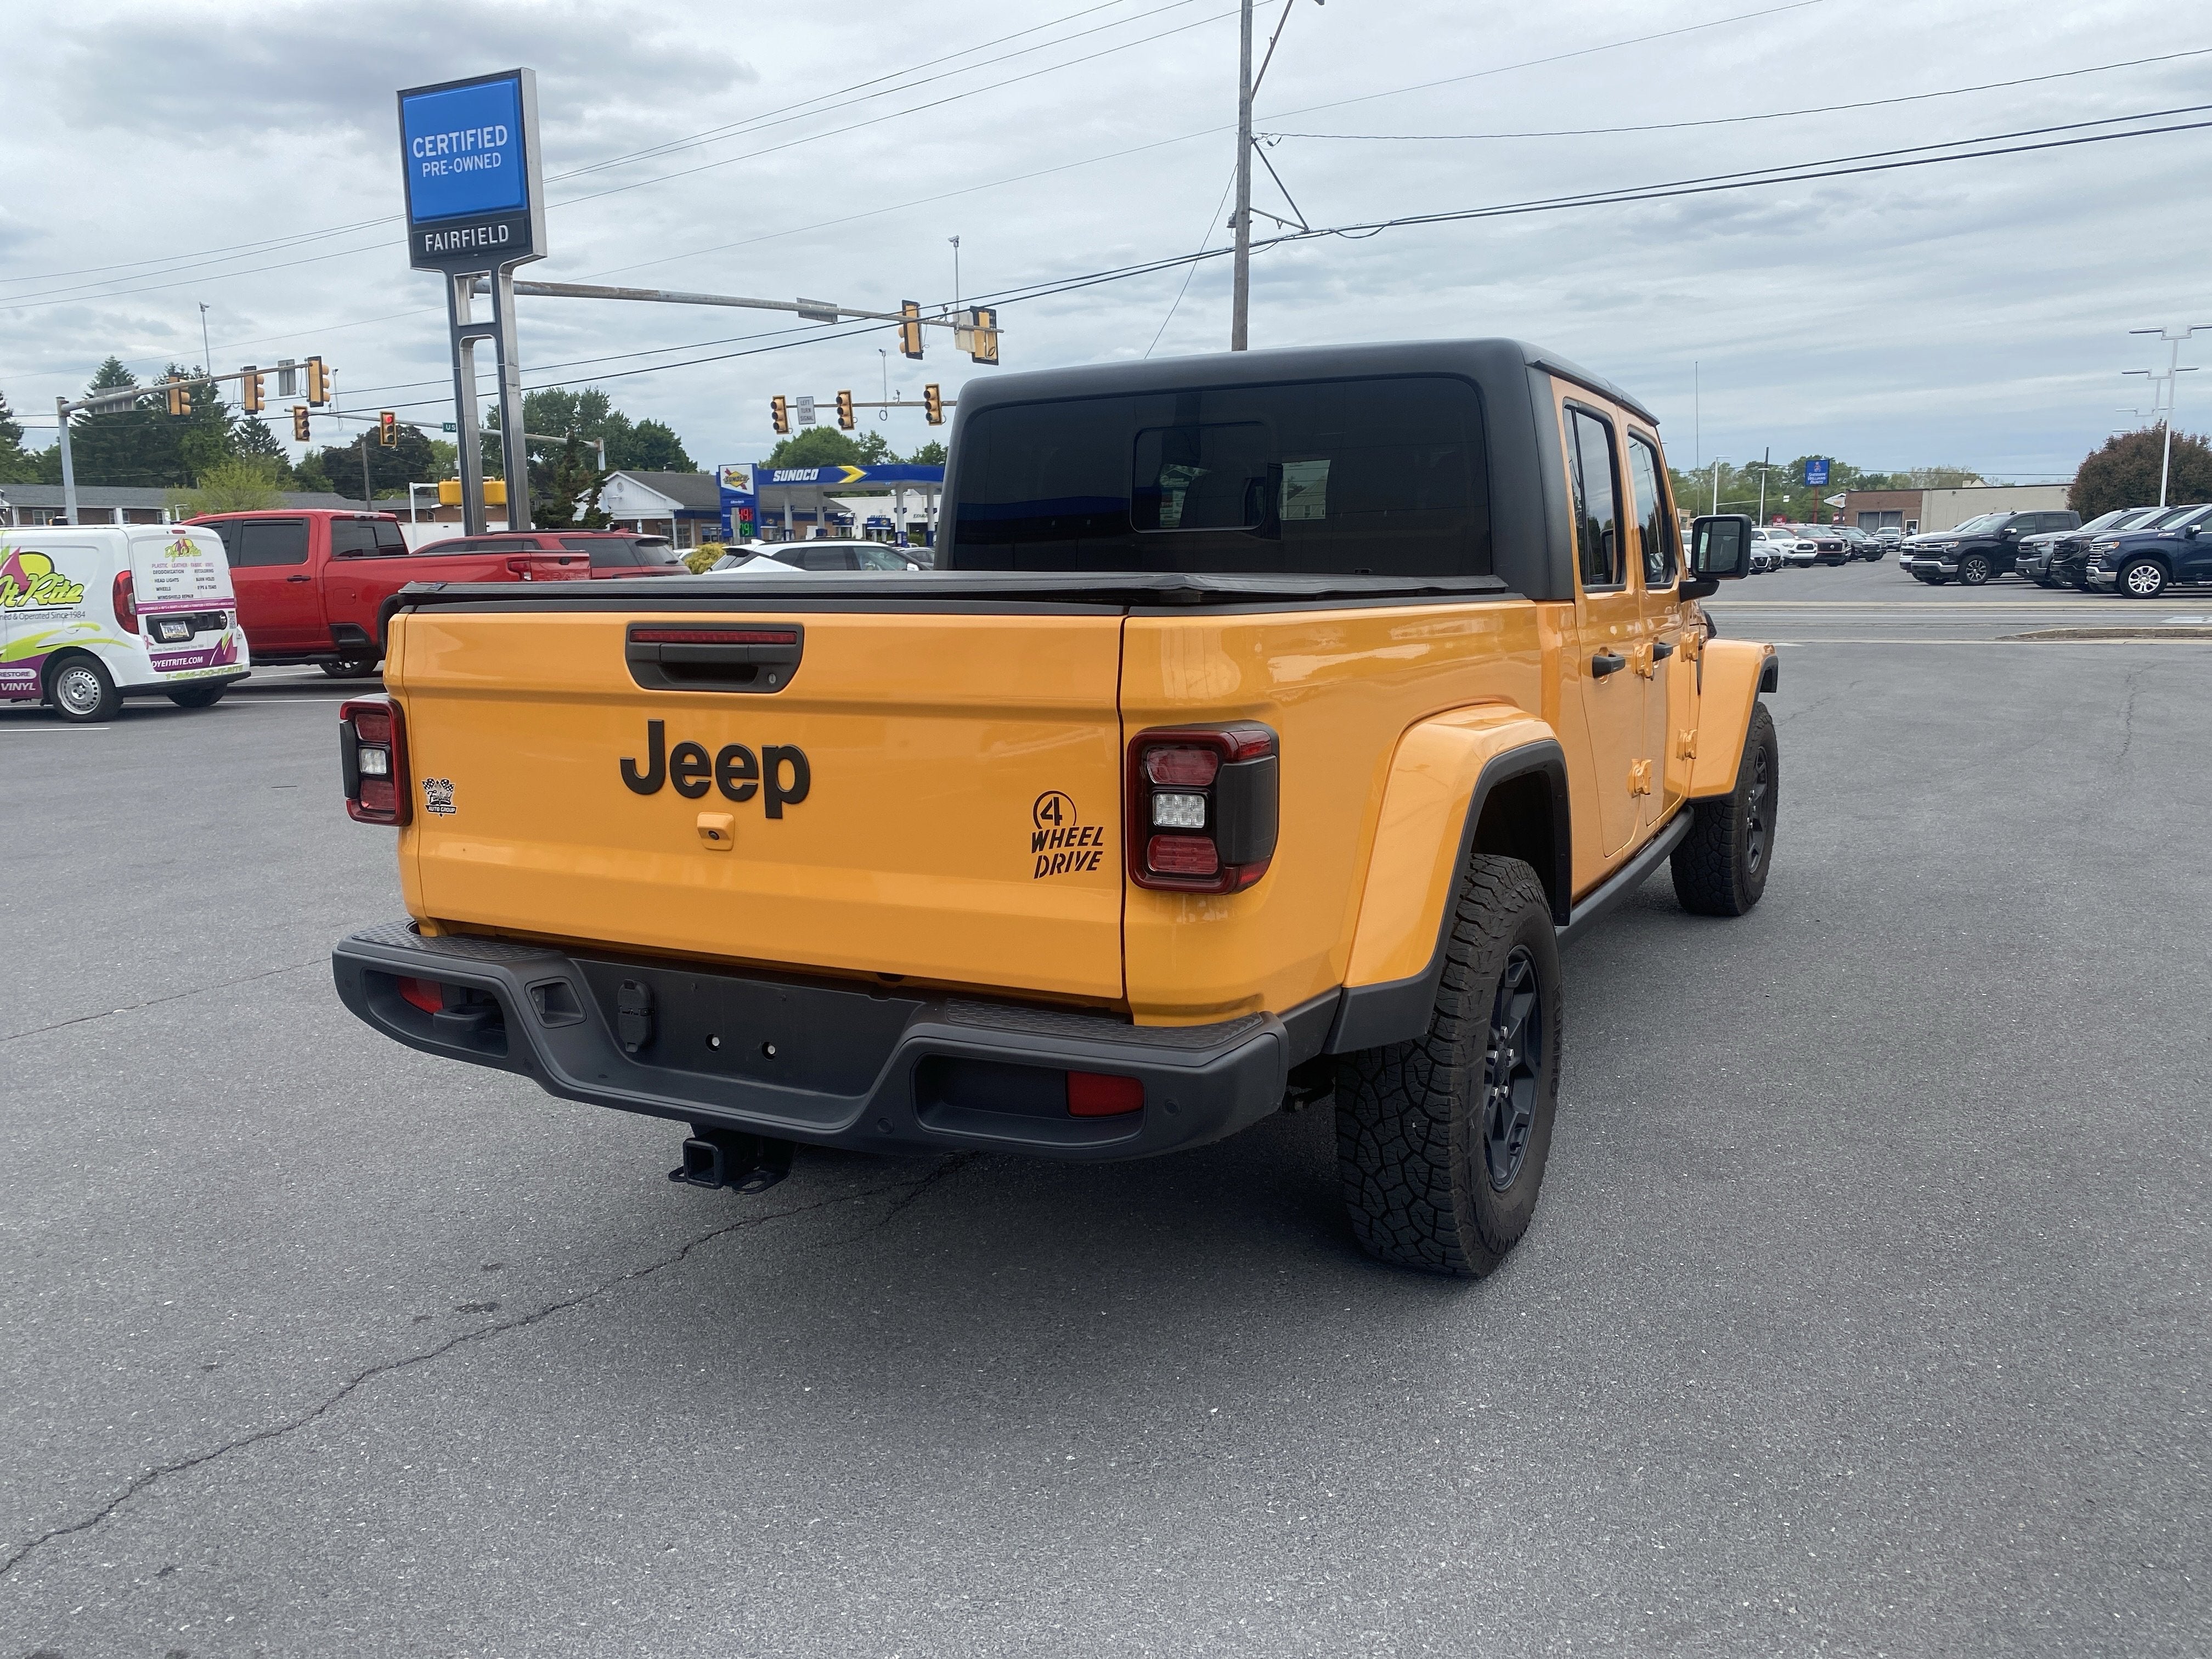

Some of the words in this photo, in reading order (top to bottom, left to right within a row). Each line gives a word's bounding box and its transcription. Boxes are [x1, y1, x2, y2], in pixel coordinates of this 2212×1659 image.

[413, 125, 507, 159] CERTIFIED
[422, 153, 501, 178] PRE-OWNED
[425, 224, 509, 252] FAIRFIELD
[772, 469, 819, 482] SUNOCO
[17, 573, 84, 606] Rite
[19, 612, 49, 621] Operated
[51, 611, 68, 619] Since
[151, 656, 204, 668] DYEITRITE.COM
[1, 682, 36, 691] VINYL
[620, 719, 811, 819] Jeep
[1040, 797, 1063, 826] 4
[1031, 826, 1104, 854] WHEEL
[1034, 851, 1104, 879] DRIVE
[1549, 982, 1561, 1099] KUMHO
